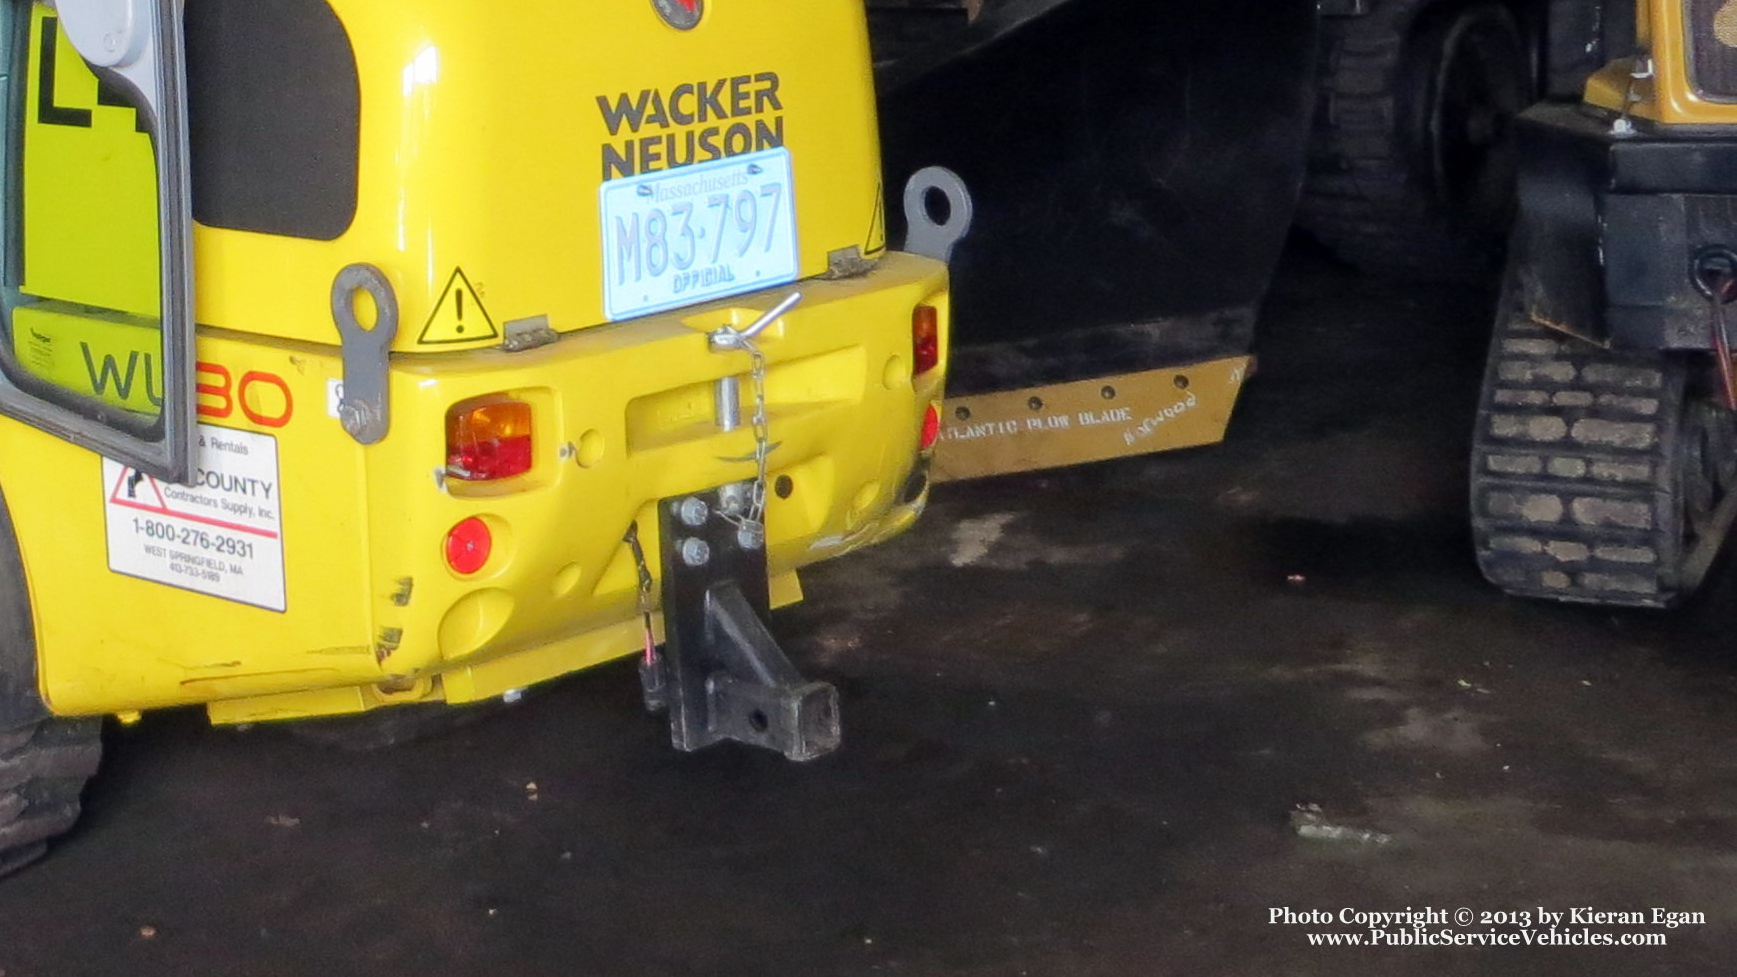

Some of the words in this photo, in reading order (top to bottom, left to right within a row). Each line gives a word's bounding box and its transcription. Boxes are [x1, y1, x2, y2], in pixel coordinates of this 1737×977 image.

[595, 71, 783, 137] WACKER
[601, 116, 784, 181] NEUSON
[673, 264, 736, 294] OFFICIAL
[211, 436, 249, 456] Rentals
[164, 486, 219, 509] Contractors
[258, 507, 275, 520] Inc.
[132, 517, 254, 559] 1-800-276-2931
[144, 544, 167, 559] WEST
[229, 563, 244, 576] MA
